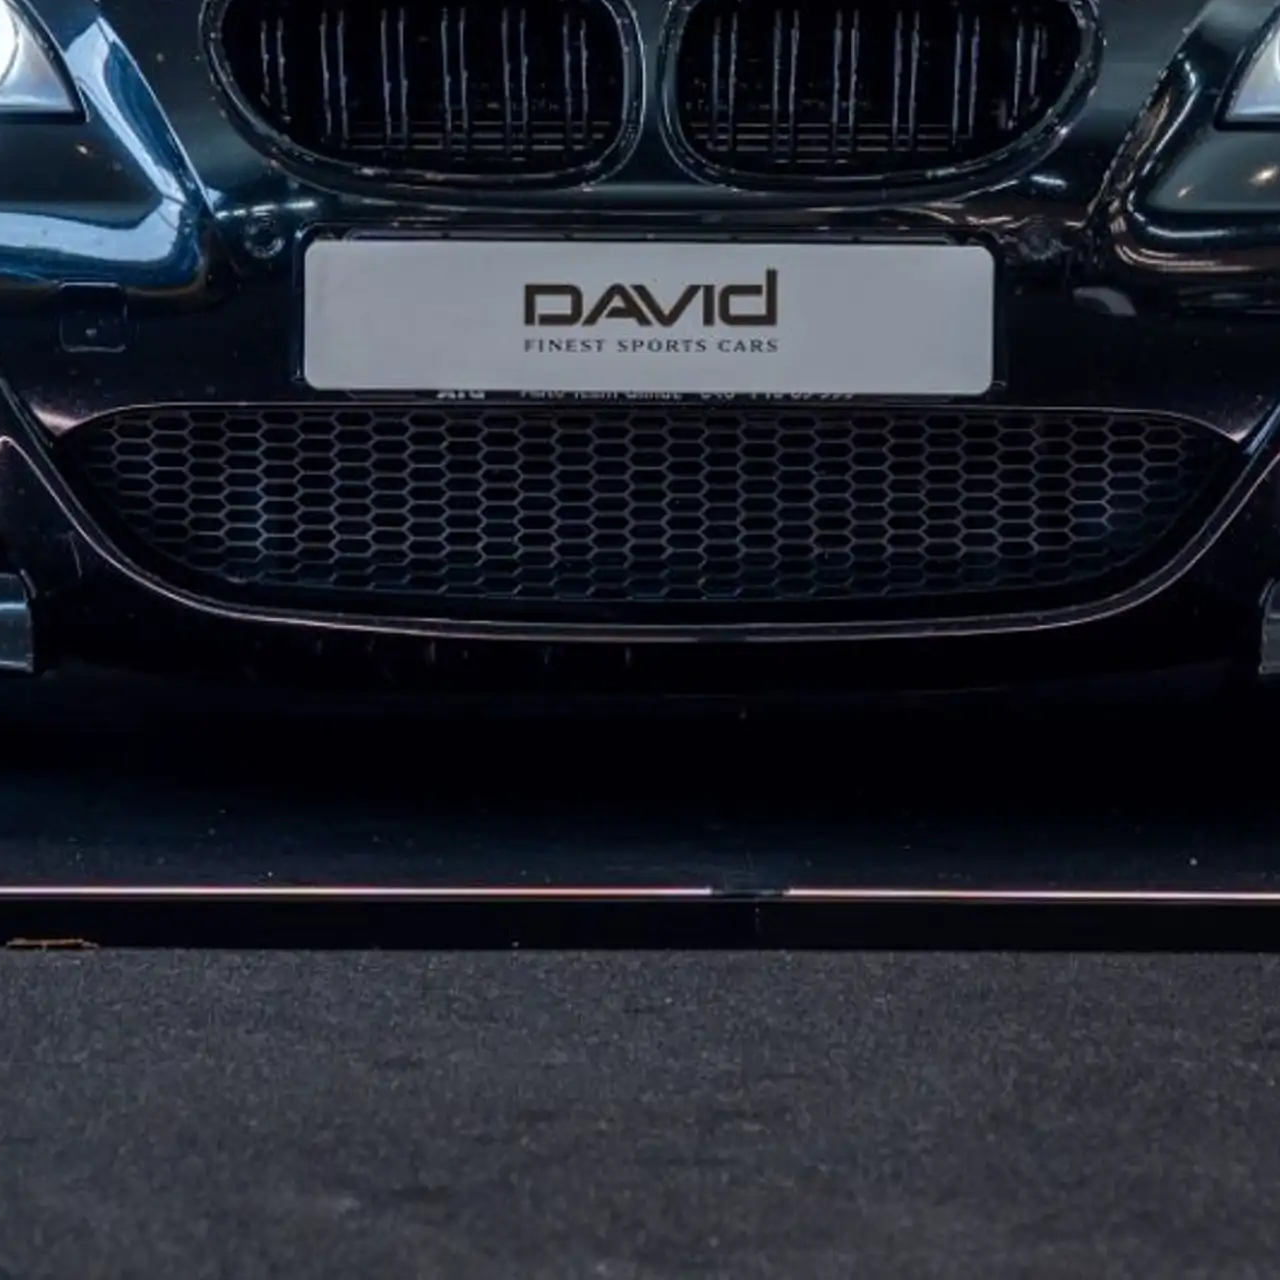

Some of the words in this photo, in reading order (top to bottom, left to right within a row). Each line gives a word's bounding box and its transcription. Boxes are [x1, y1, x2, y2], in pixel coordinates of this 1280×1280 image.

[523, 338, 606, 353] FINEST
[617, 338, 707, 353] SPORTS
[717, 338, 778, 353] CARS
